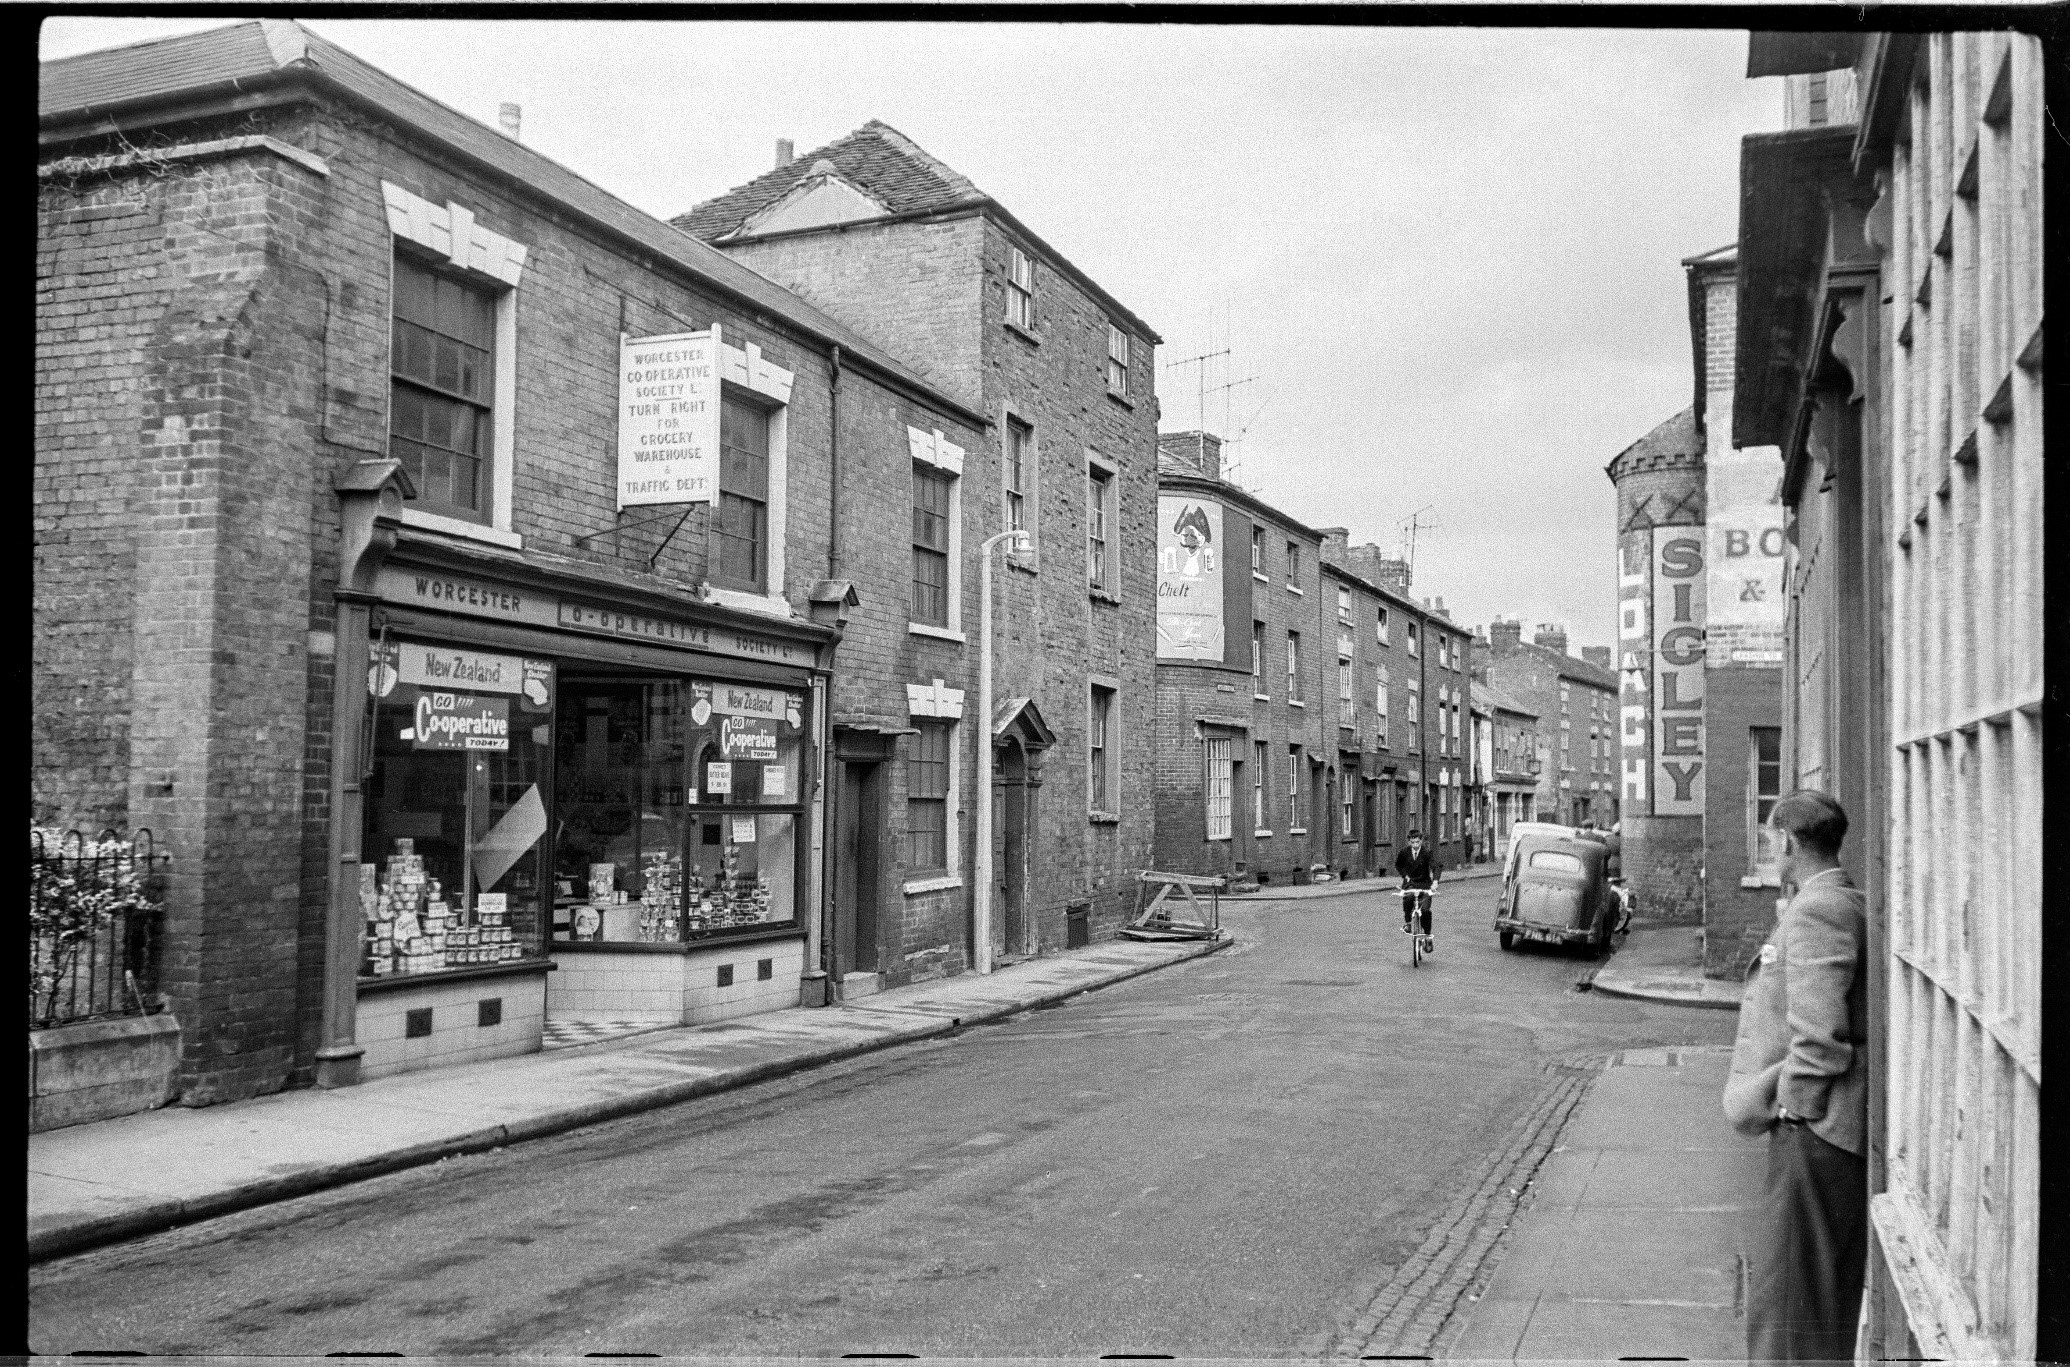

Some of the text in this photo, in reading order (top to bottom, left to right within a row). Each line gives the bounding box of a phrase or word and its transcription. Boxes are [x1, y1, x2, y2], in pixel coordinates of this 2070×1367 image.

[634, 350, 704, 365] WORCESTER
[636, 384, 684, 397] SOCIETY
[628, 400, 706, 417] TURN RIGHT
[657, 418, 680, 430] FOR
[640, 431, 693, 446] GROCERY
[634, 448, 702, 462] WAREHOUSE
[625, 481, 670, 494] TRAFFIC
[1739, 579, 1765, 602] &
[415, 577, 521, 612] WORCESTER
[736, 636, 777, 655] SOCIETY
[425, 652, 502, 683] New Zealand
[1661, 537, 1703, 801] SIGLEY
[435, 695, 452, 708] GO
[727, 690, 773, 713] New Zealand
[416, 695, 507, 742] Co-operative
[732, 717, 743, 728] GO
[469, 739, 505, 748] TODAY!
[721, 718, 777, 755] Co-operative
